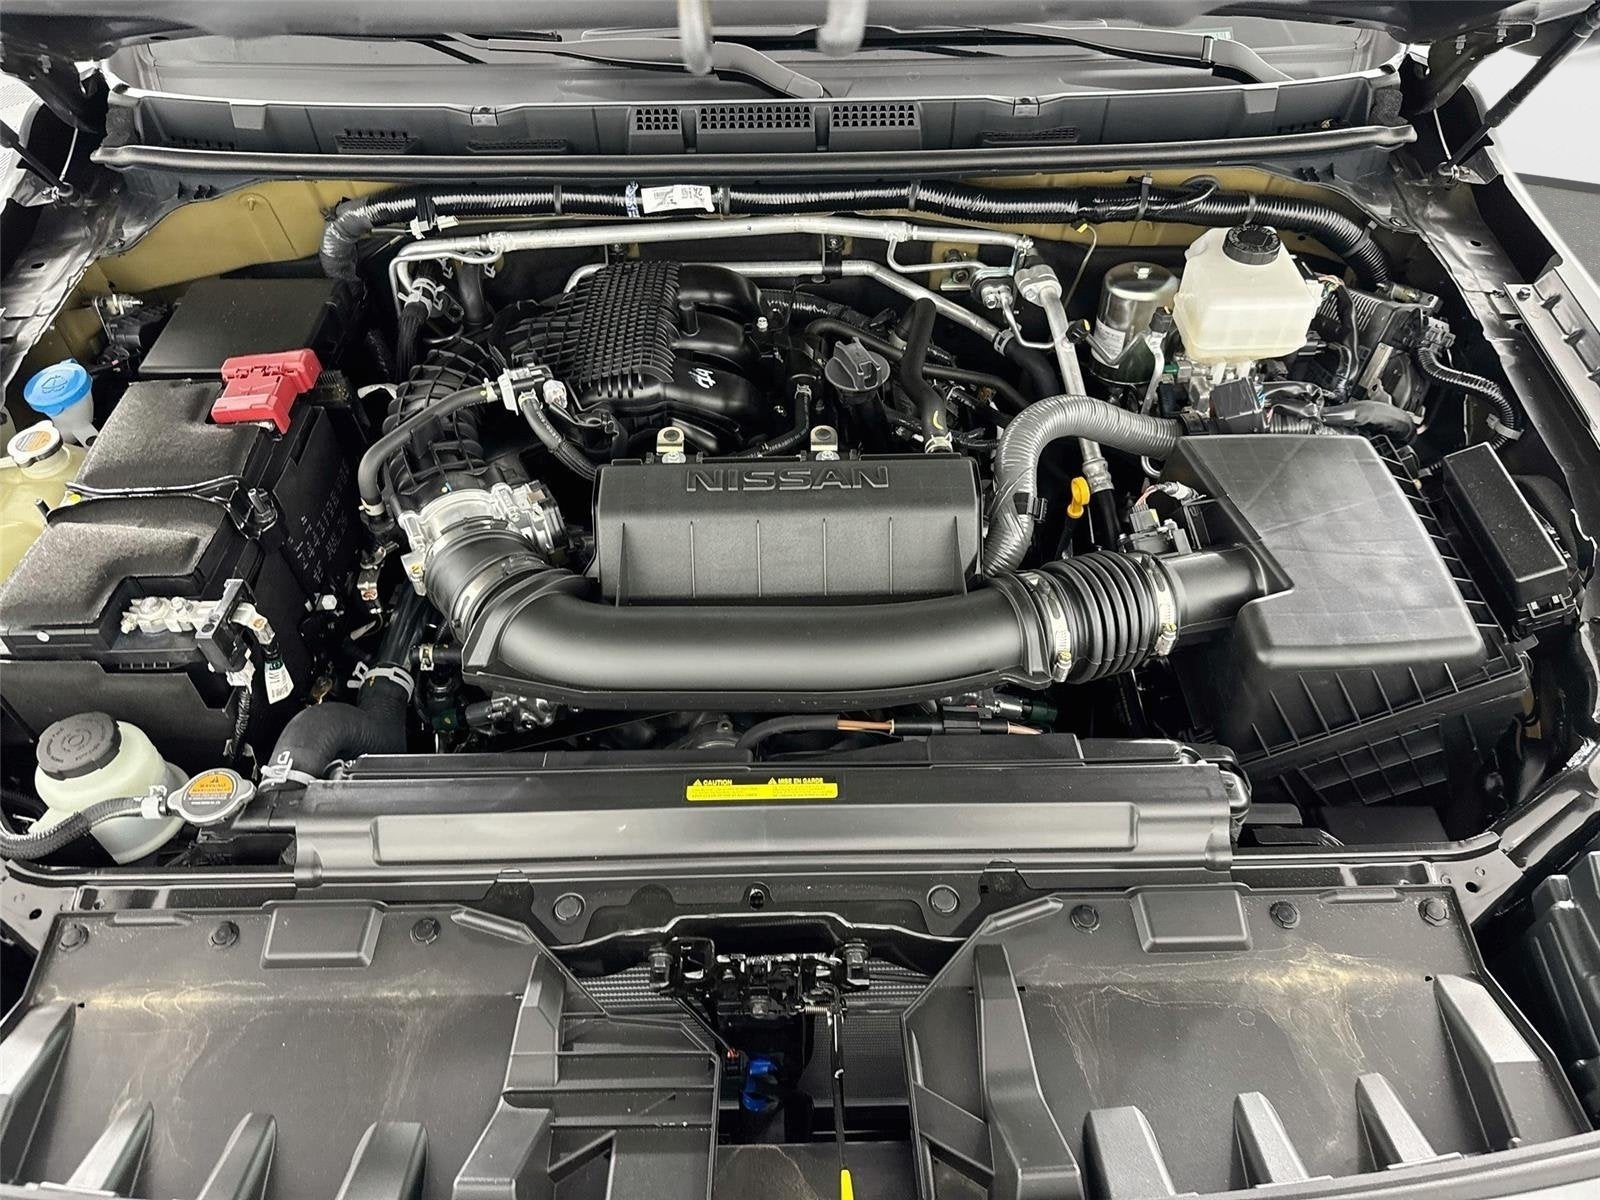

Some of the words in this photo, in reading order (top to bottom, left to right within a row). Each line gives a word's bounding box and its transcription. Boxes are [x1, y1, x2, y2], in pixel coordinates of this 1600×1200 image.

[686, 466, 889, 492] NISSAN
[702, 779, 733, 787] CAUTION
[777, 777, 792, 785] MISE
[794, 777, 801, 785] EN
[802, 777, 824, 785] GARDE
